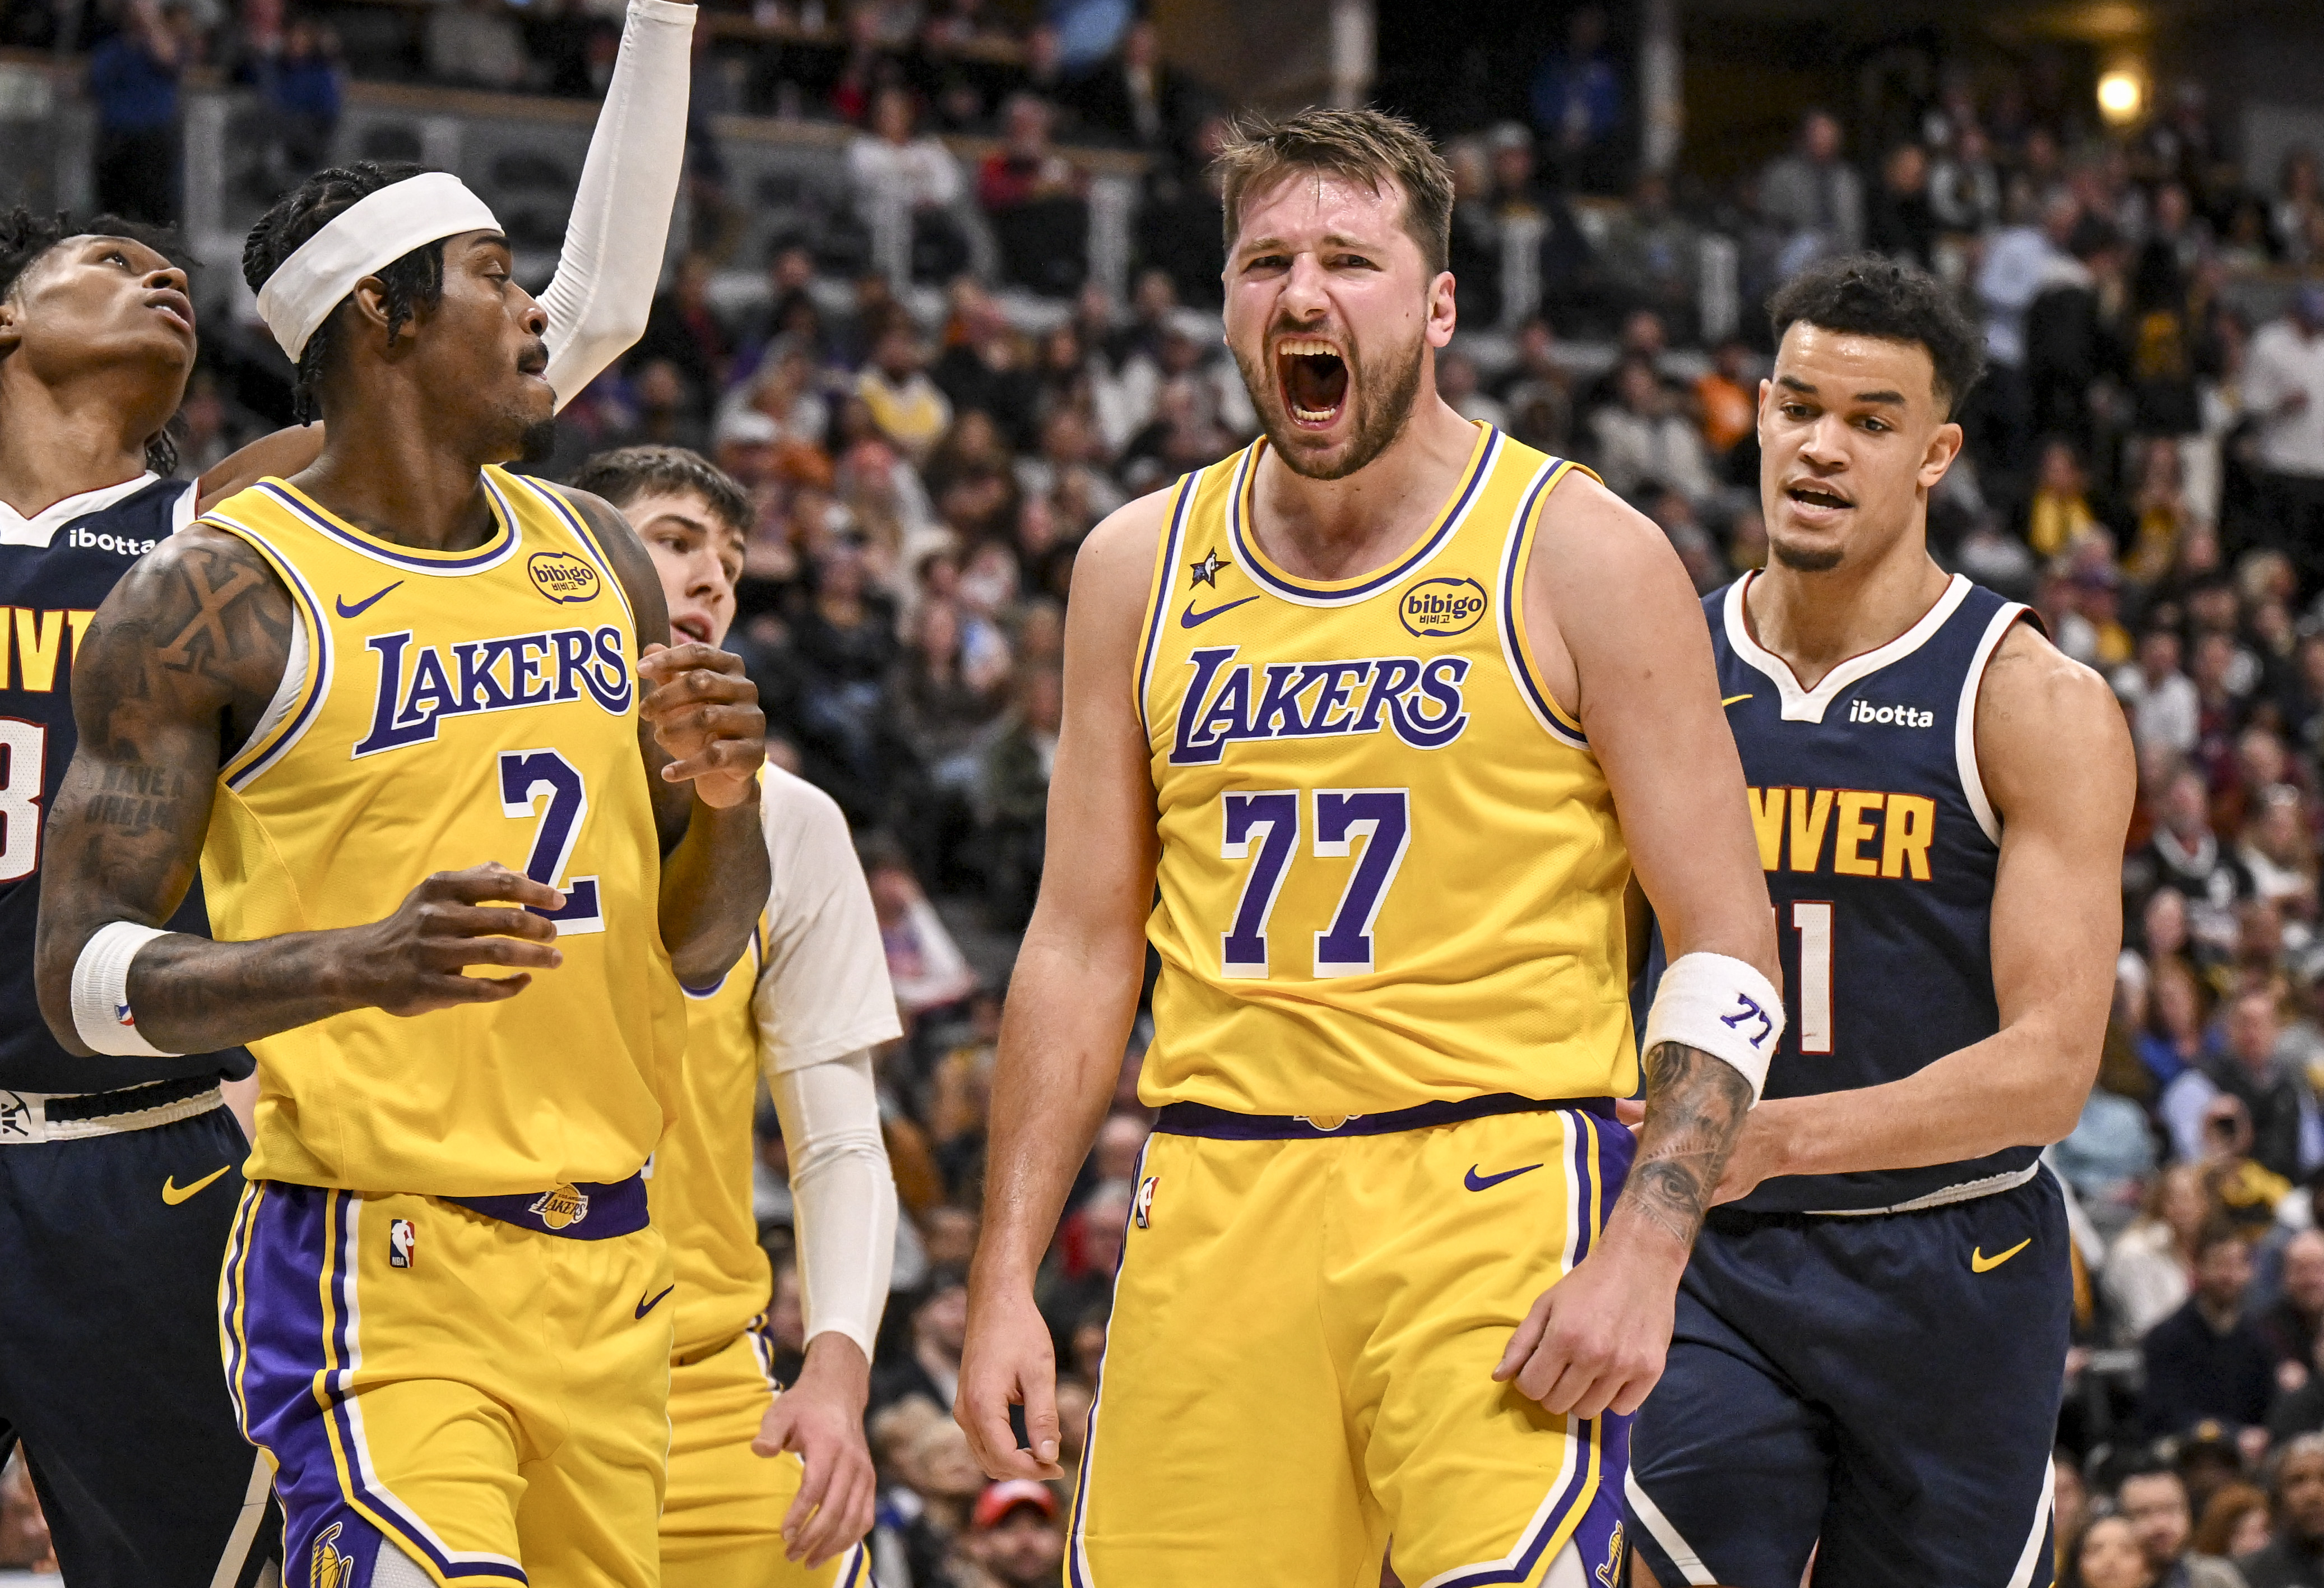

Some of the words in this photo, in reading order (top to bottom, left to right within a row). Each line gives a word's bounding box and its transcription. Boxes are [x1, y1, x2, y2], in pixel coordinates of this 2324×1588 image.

[69, 527, 156, 555] ibotta
[532, 564, 593, 586] bibigo
[551, 581, 579, 592] 비비고
[1408, 593, 1482, 619] bibigo
[1419, 614, 1450, 624] 비비고
[350, 624, 633, 761] LAKERS
[1167, 645, 1473, 766] LAKERS
[1849, 700, 1934, 728] ibotta
[497, 747, 606, 936] 2
[1221, 788, 1411, 979] 77
[1771, 900, 1834, 1055] 1
[1720, 993, 1773, 1050] 77
[532, 1192, 587, 1221] LAKERS
[392, 1256, 405, 1266] NBA
